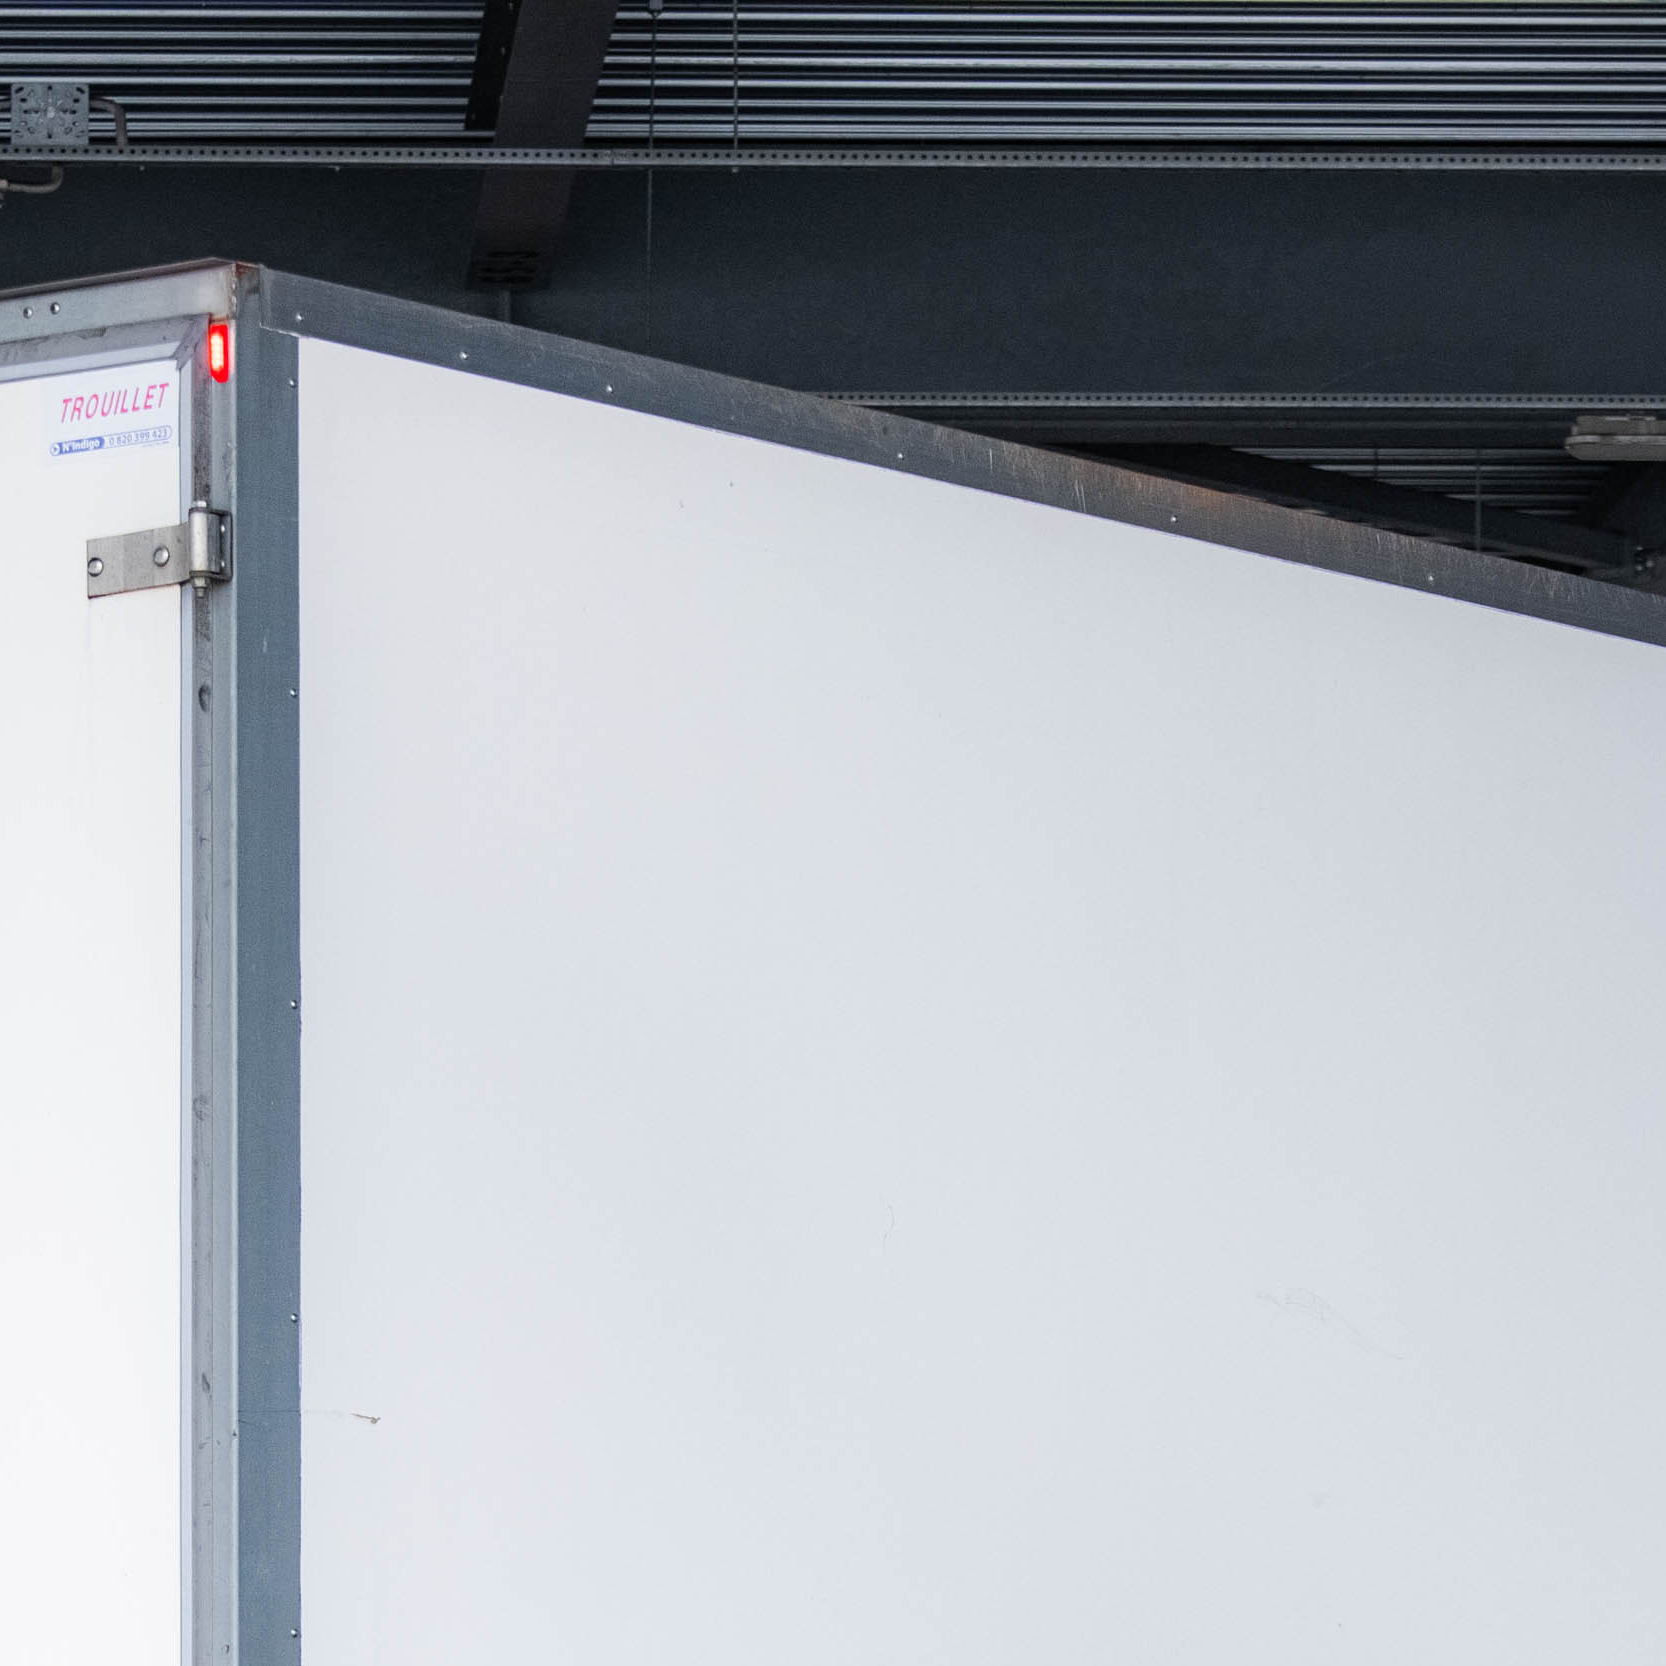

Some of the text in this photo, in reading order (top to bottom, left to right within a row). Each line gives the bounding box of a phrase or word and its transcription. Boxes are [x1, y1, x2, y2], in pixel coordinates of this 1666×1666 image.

[61, 382, 170, 424] TROUILLET
[116, 435, 133, 446] 820
[135, 431, 150, 442] 399
[152, 428, 168, 439] 423
